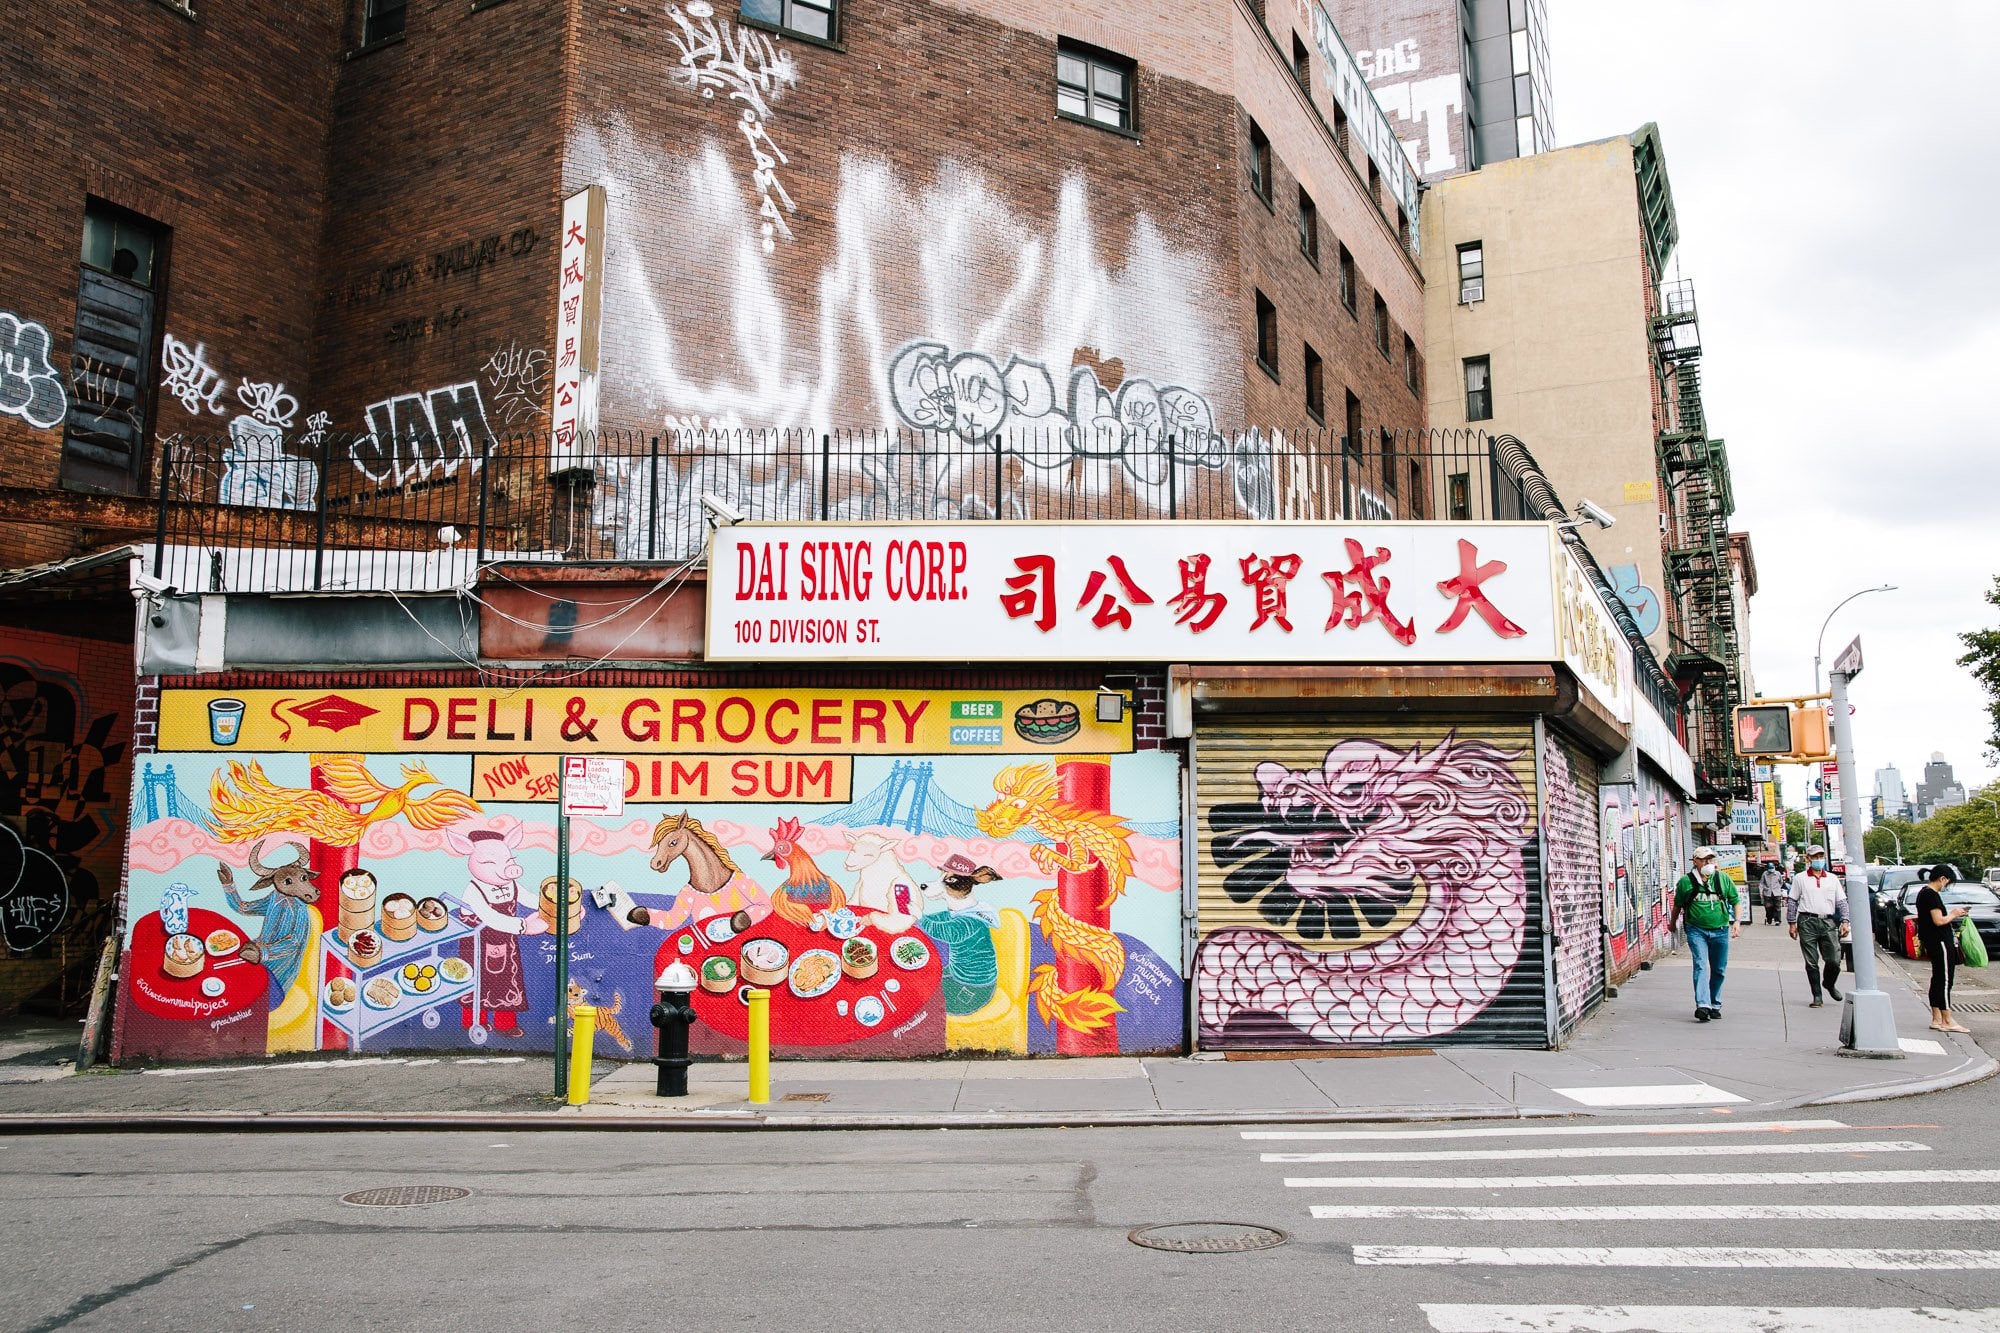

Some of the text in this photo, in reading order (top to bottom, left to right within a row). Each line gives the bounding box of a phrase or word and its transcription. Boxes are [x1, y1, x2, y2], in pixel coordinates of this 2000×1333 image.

[349, 381, 498, 487] JAM
[736, 540, 968, 602] DAI SING CORP.
[735, 618, 880, 644] 100 DIVISION ST.
[403, 696, 930, 745] DELI & GROCERY
[961, 704, 995, 716] BEER
[953, 728, 1000, 742] COFFEE
[483, 755, 530, 797] NOW
[731, 759, 833, 799] SUM
